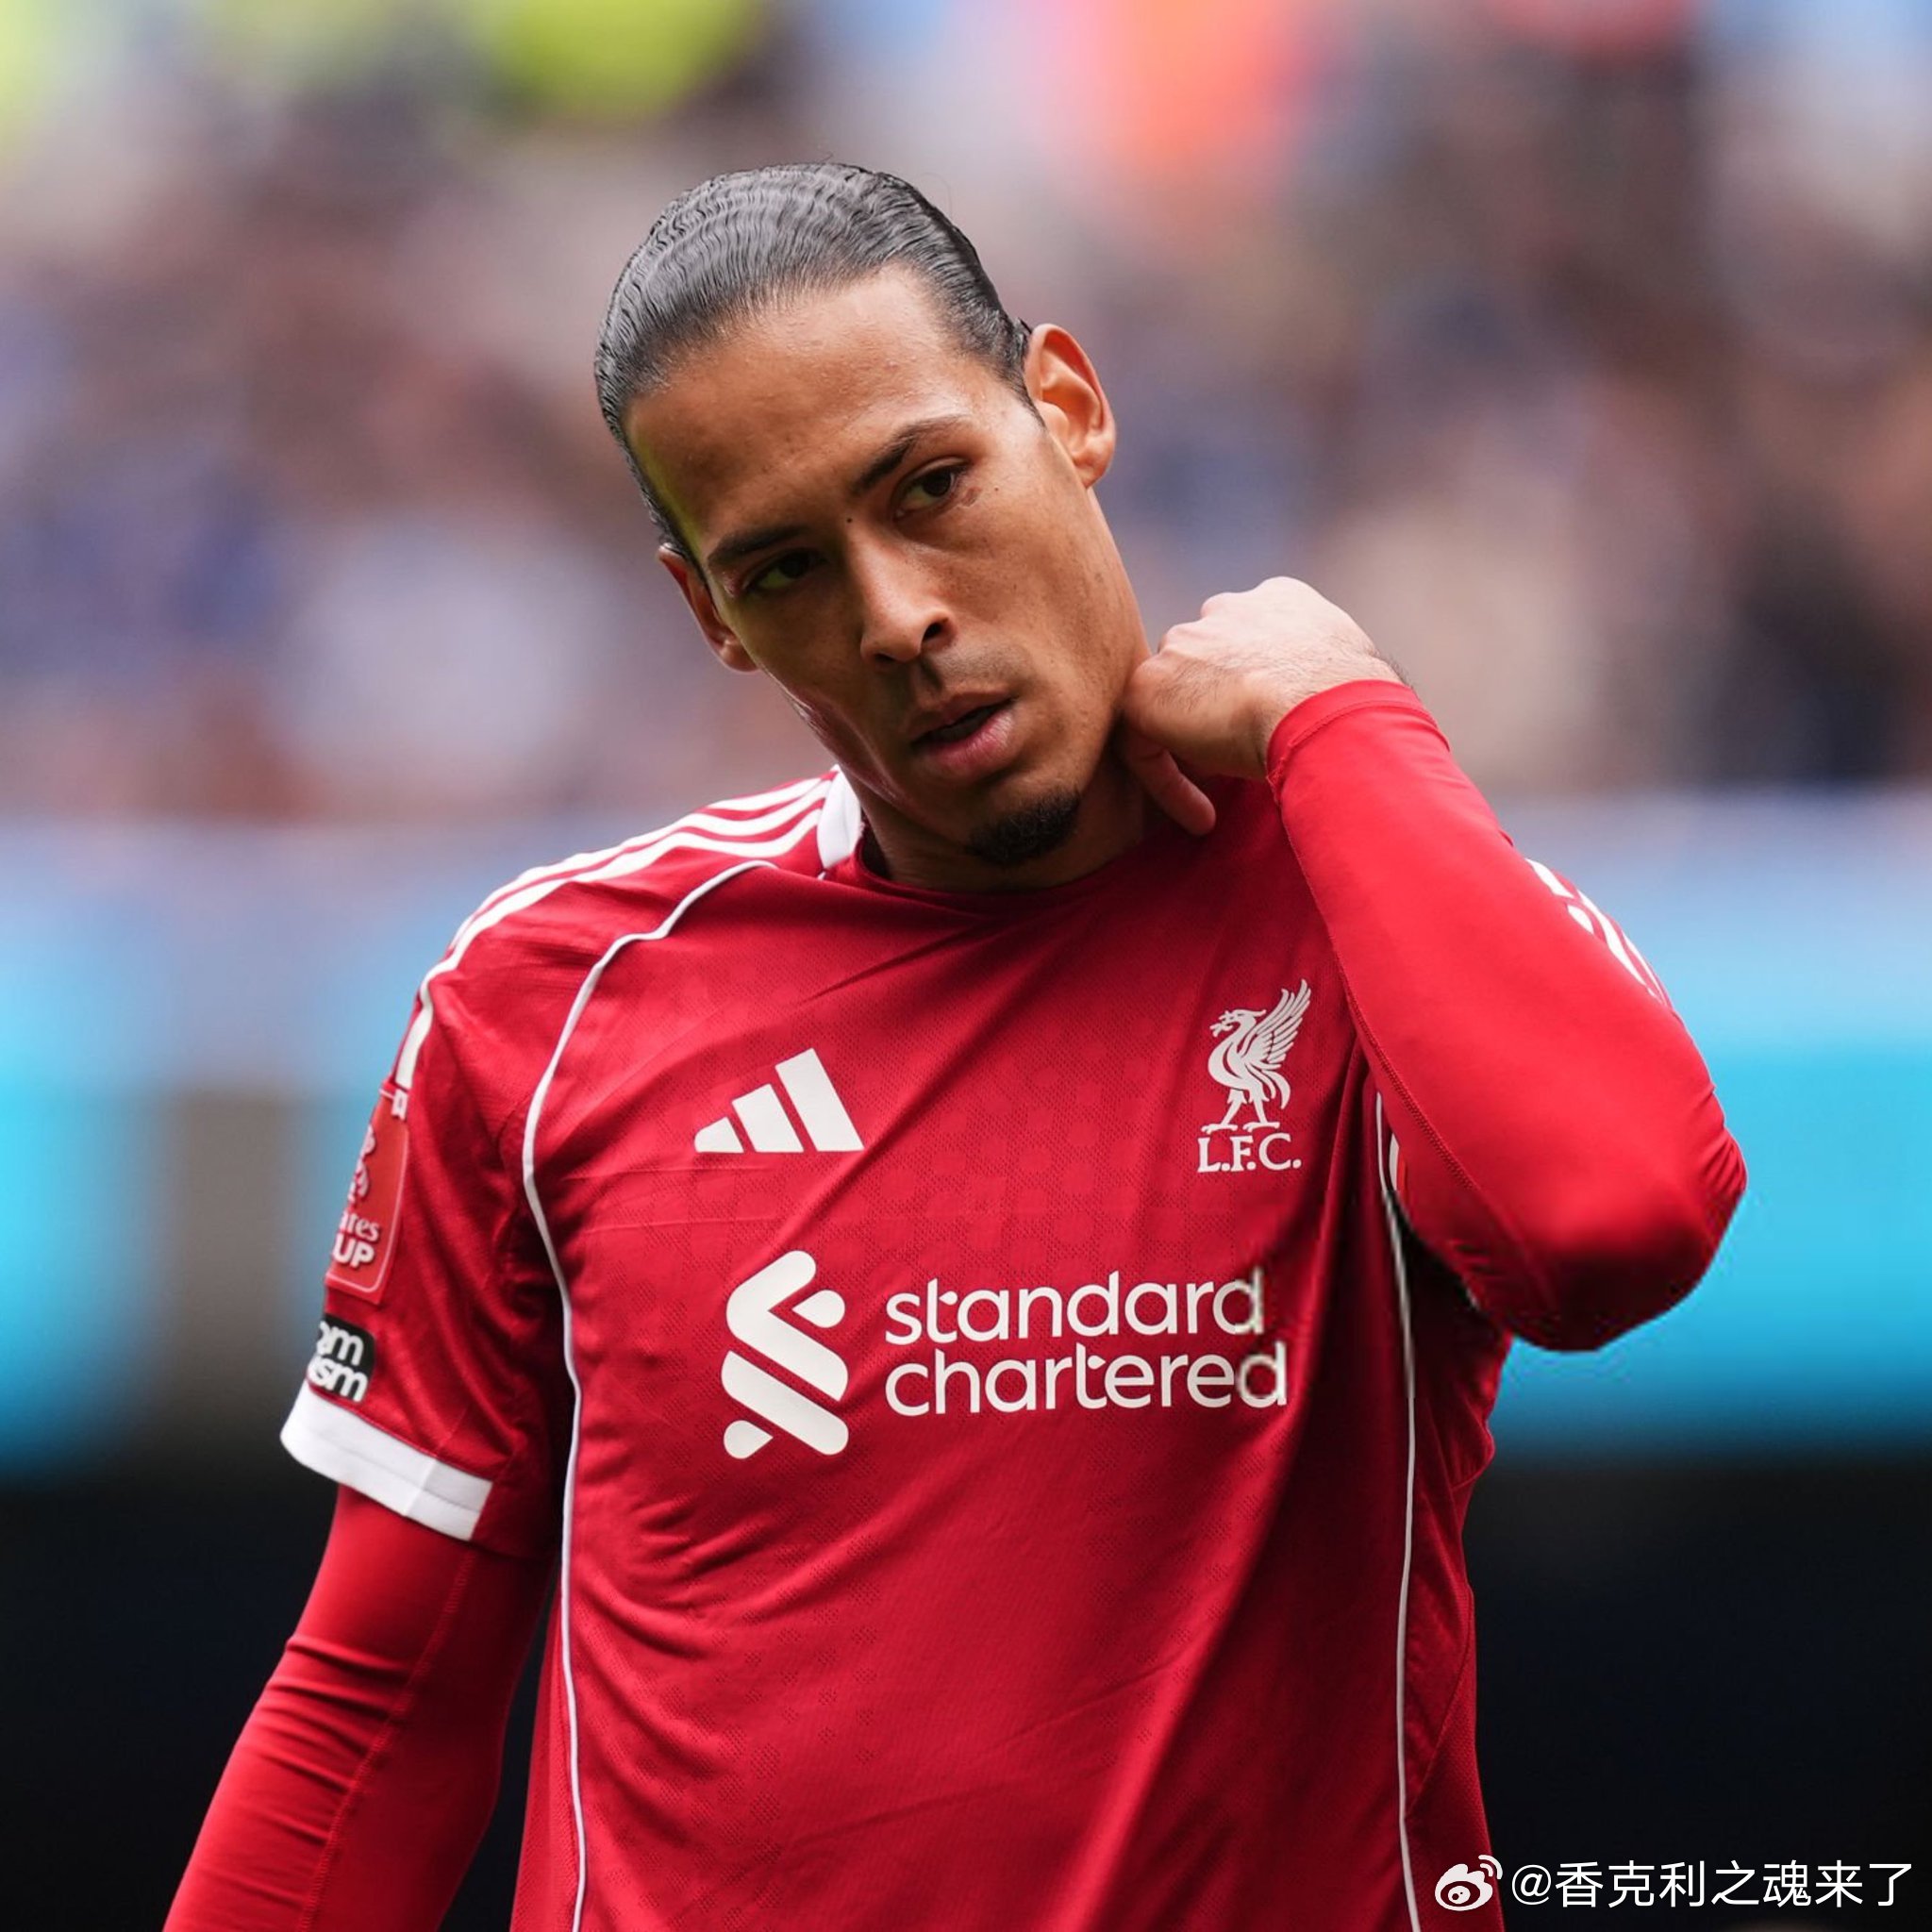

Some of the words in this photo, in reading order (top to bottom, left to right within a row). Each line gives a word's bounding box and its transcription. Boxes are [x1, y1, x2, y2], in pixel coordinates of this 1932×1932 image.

[1197, 1133, 1302, 1173] L.F.C.
[885, 1265, 1265, 1345] standard
[885, 1341, 1288, 1416] chartered
